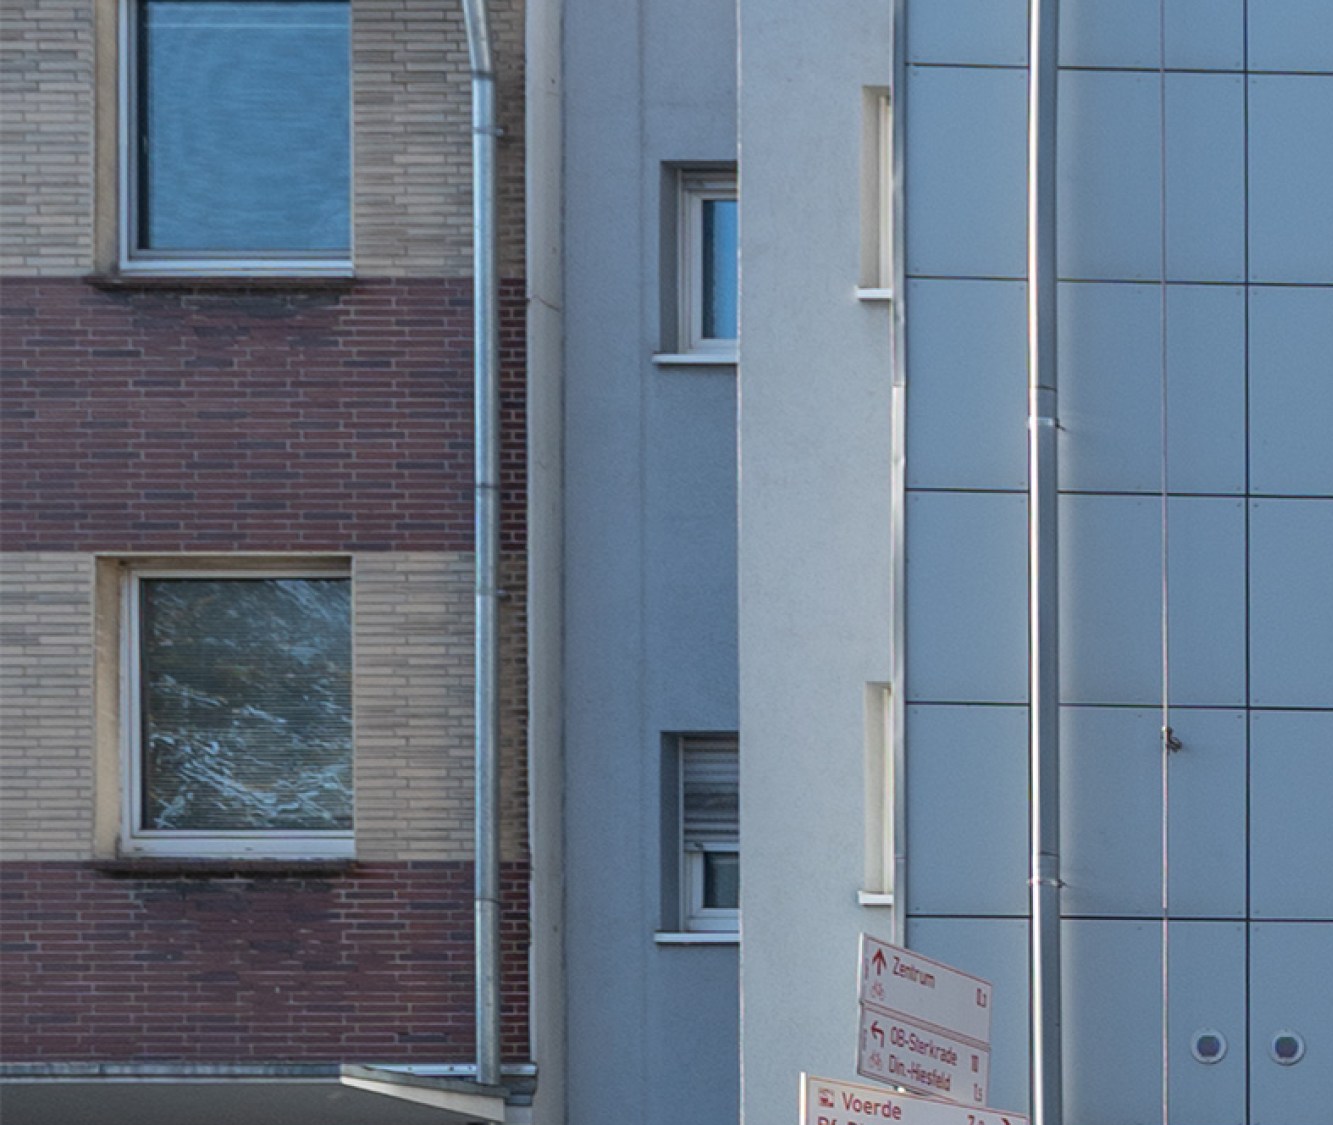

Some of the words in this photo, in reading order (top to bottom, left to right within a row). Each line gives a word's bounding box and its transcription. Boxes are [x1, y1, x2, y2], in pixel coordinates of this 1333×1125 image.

[892, 955, 936, 989] Zentrum
[889, 1025, 958, 1067] OB-Sterkrade
[888, 1053, 952, 1092] Din.-Hiesfeld
[841, 1091, 903, 1121] Voerde
